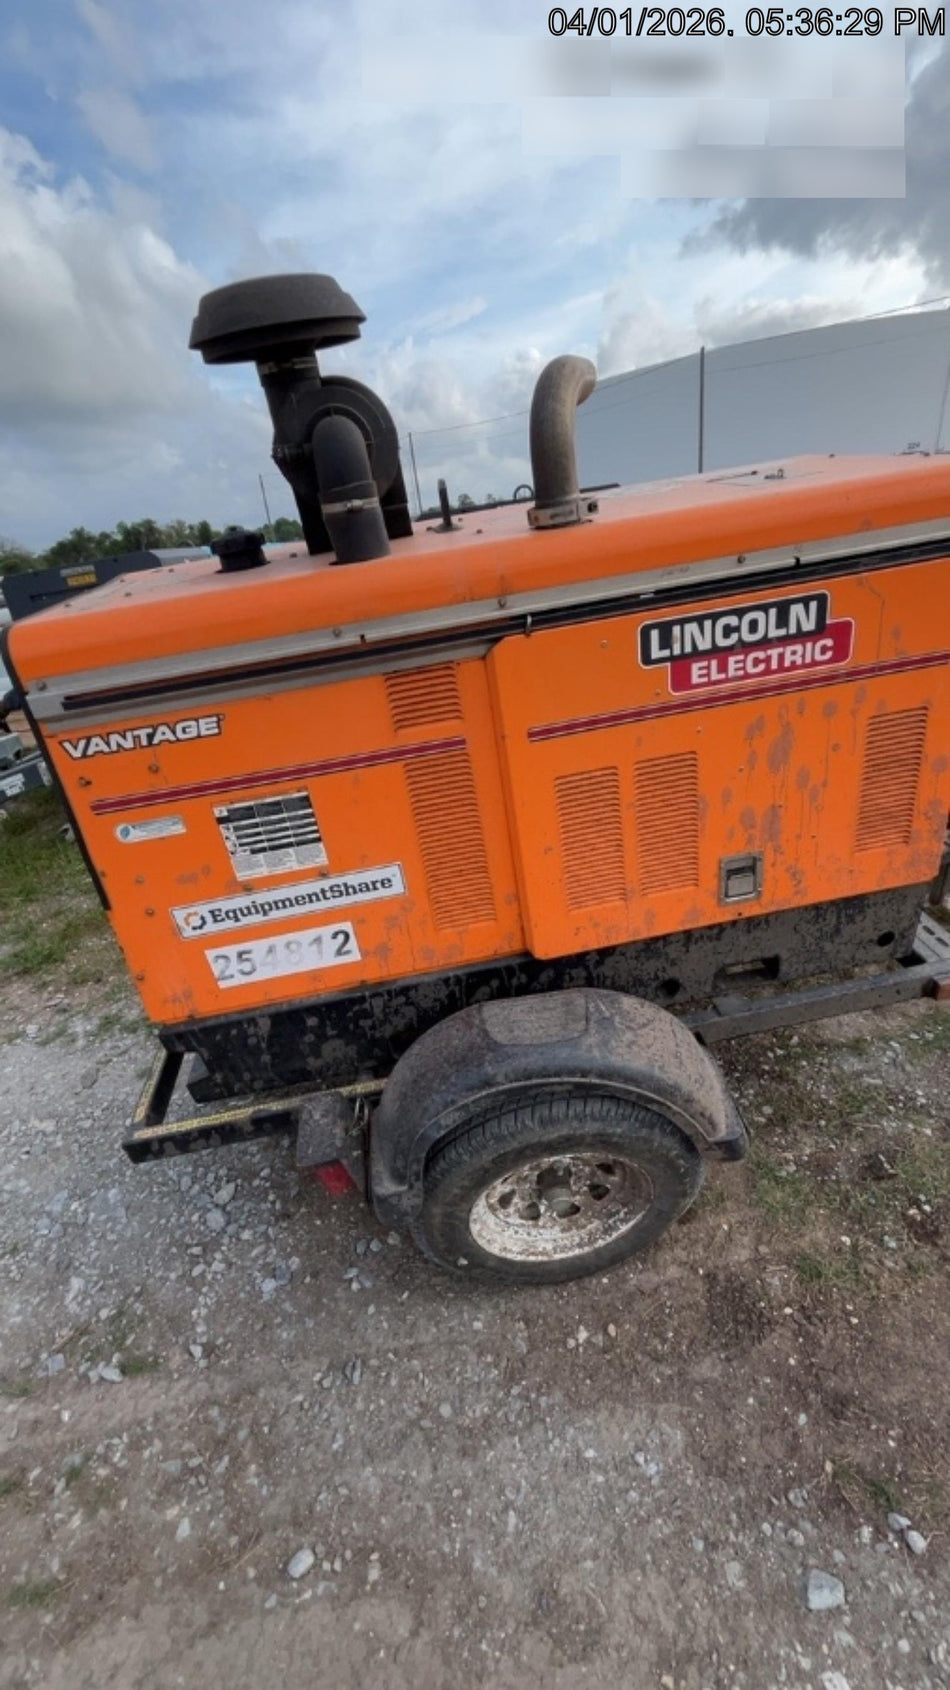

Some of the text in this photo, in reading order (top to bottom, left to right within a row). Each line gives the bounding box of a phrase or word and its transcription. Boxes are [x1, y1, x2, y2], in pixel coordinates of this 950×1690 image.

[649, 600, 818, 660] LINCOLN
[690, 637, 834, 685] ELECTRIC
[61, 715, 221, 759] VANTAGE
[208, 875, 393, 924] EquipmentShare
[212, 929, 353, 981] 254812
